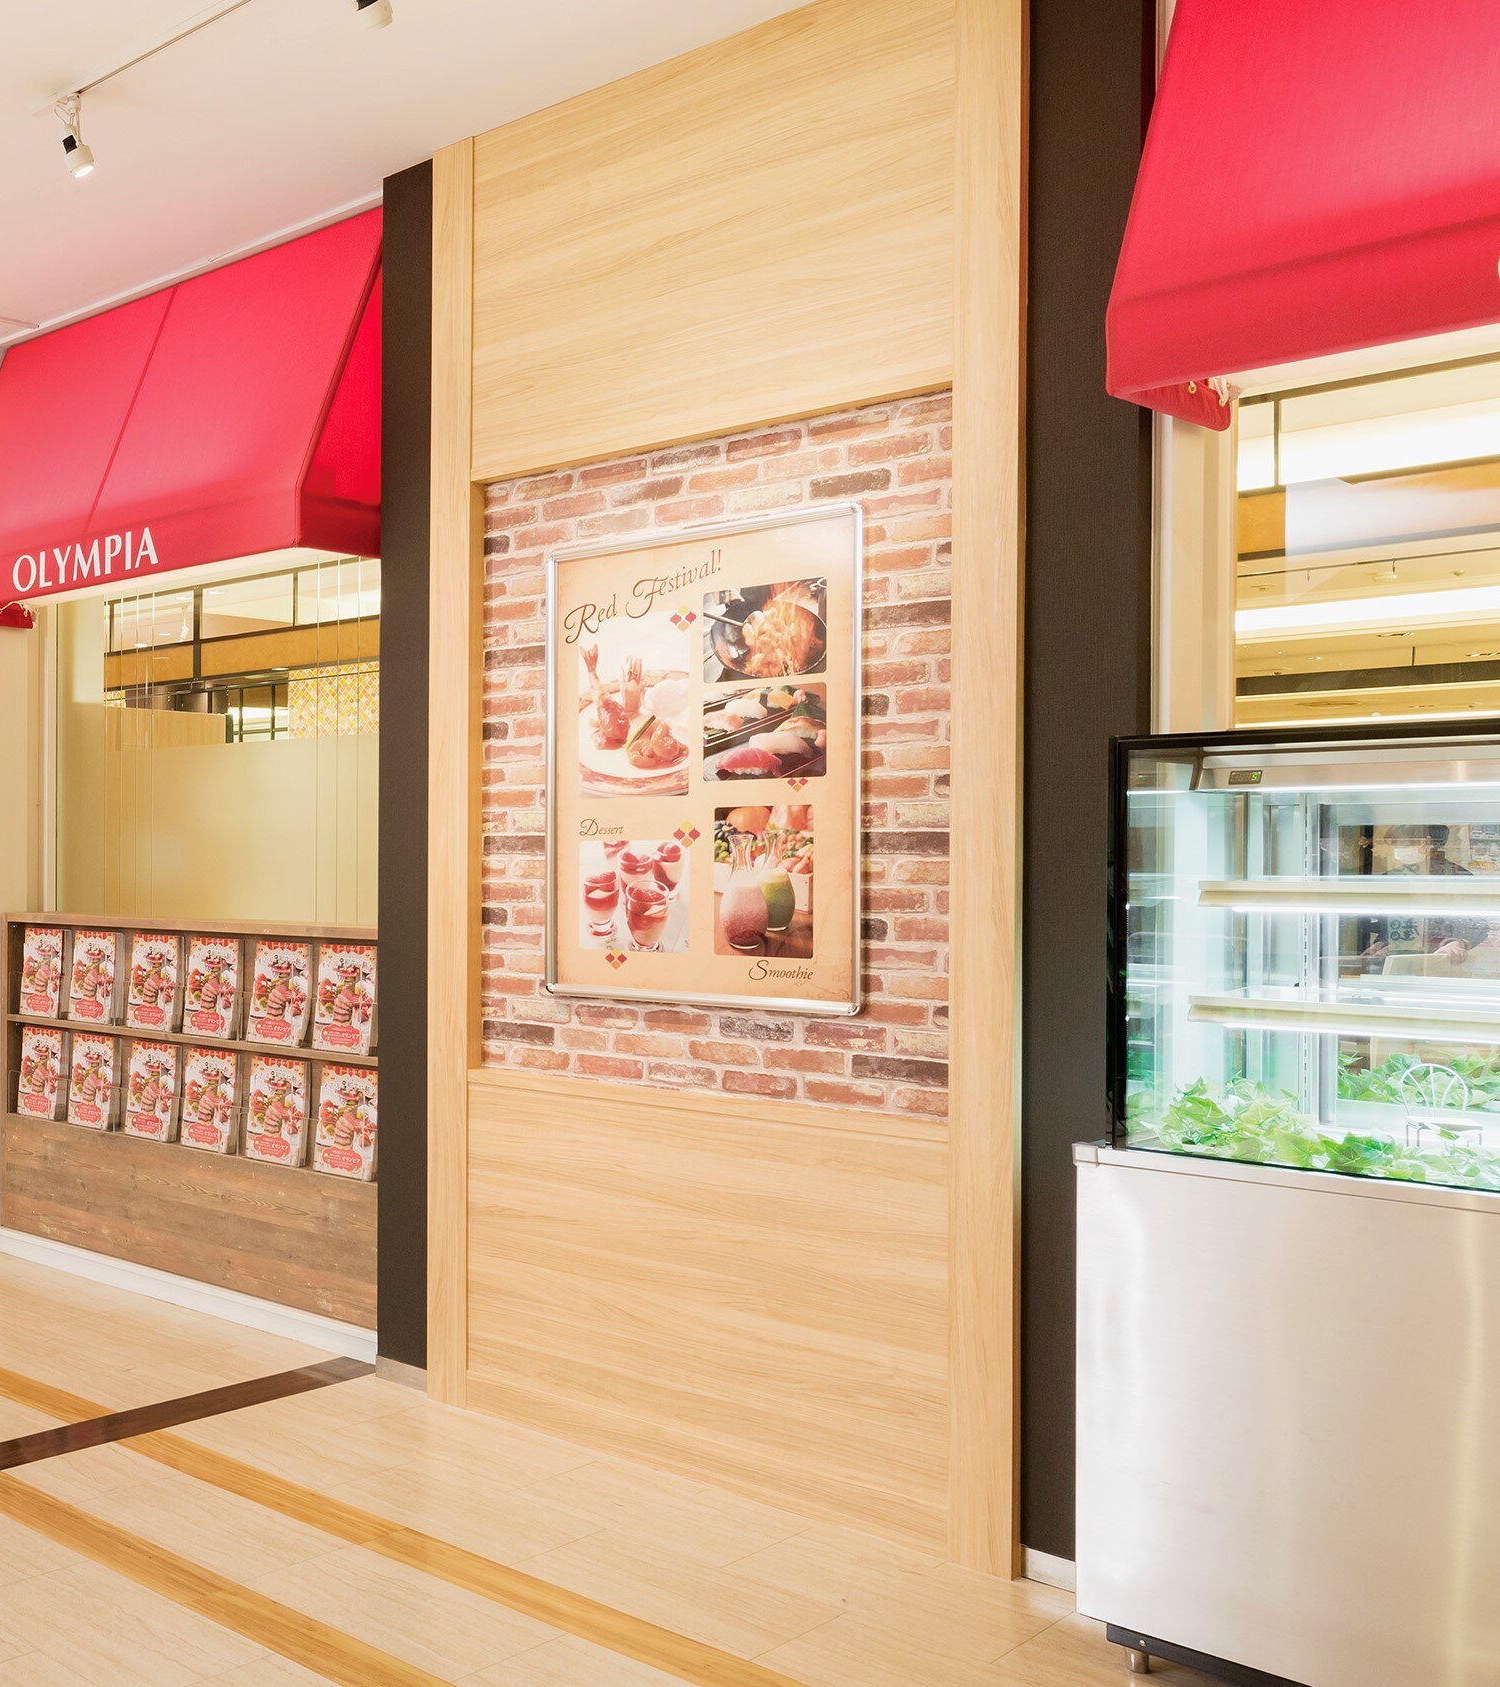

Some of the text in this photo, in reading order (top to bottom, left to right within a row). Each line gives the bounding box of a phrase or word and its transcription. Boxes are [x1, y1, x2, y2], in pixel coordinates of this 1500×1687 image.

[12, 527, 159, 593] OLYMPIA
[563, 549, 722, 644] Red Festival!
[579, 818, 624, 836] Dessert
[748, 959, 814, 980] Smoothie
